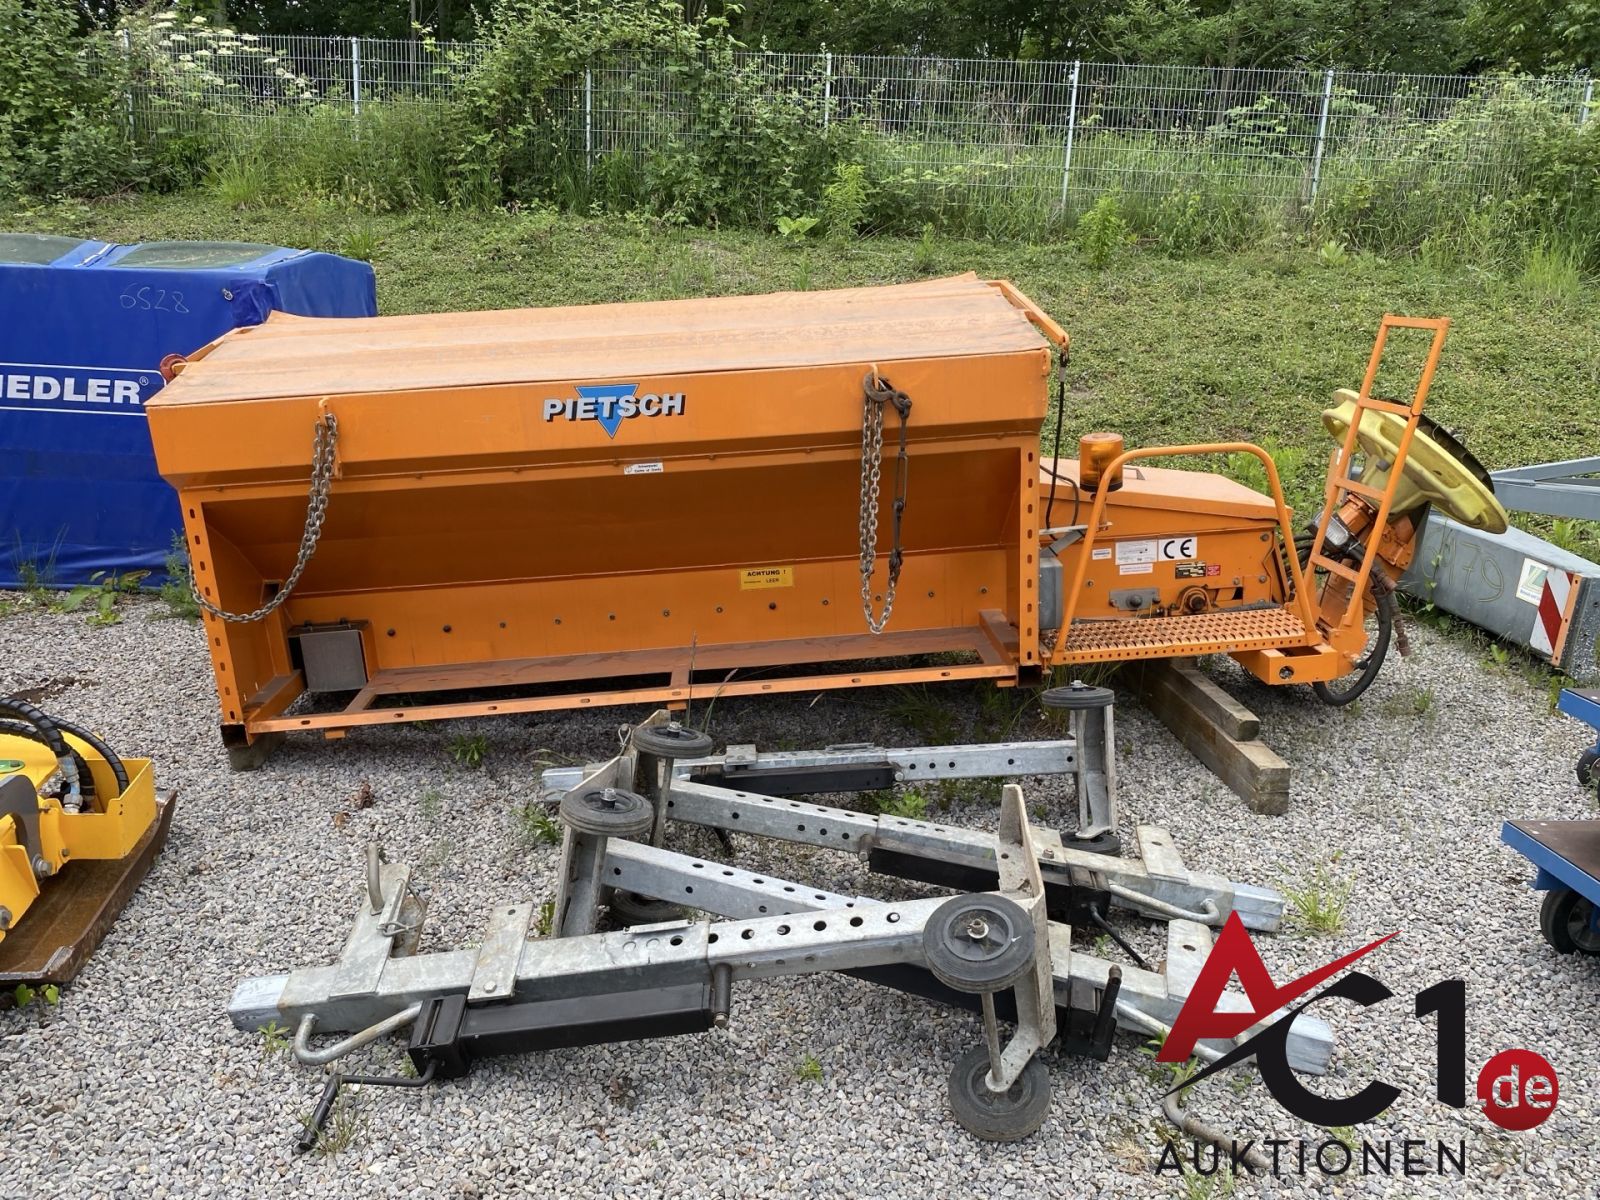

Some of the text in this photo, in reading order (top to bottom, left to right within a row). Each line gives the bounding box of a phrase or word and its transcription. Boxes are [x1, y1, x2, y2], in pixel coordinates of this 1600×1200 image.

[543, 393, 686, 422] PIETSCH
[1163, 538, 1193, 560] CE
[747, 569, 781, 577] ACHTUNG
